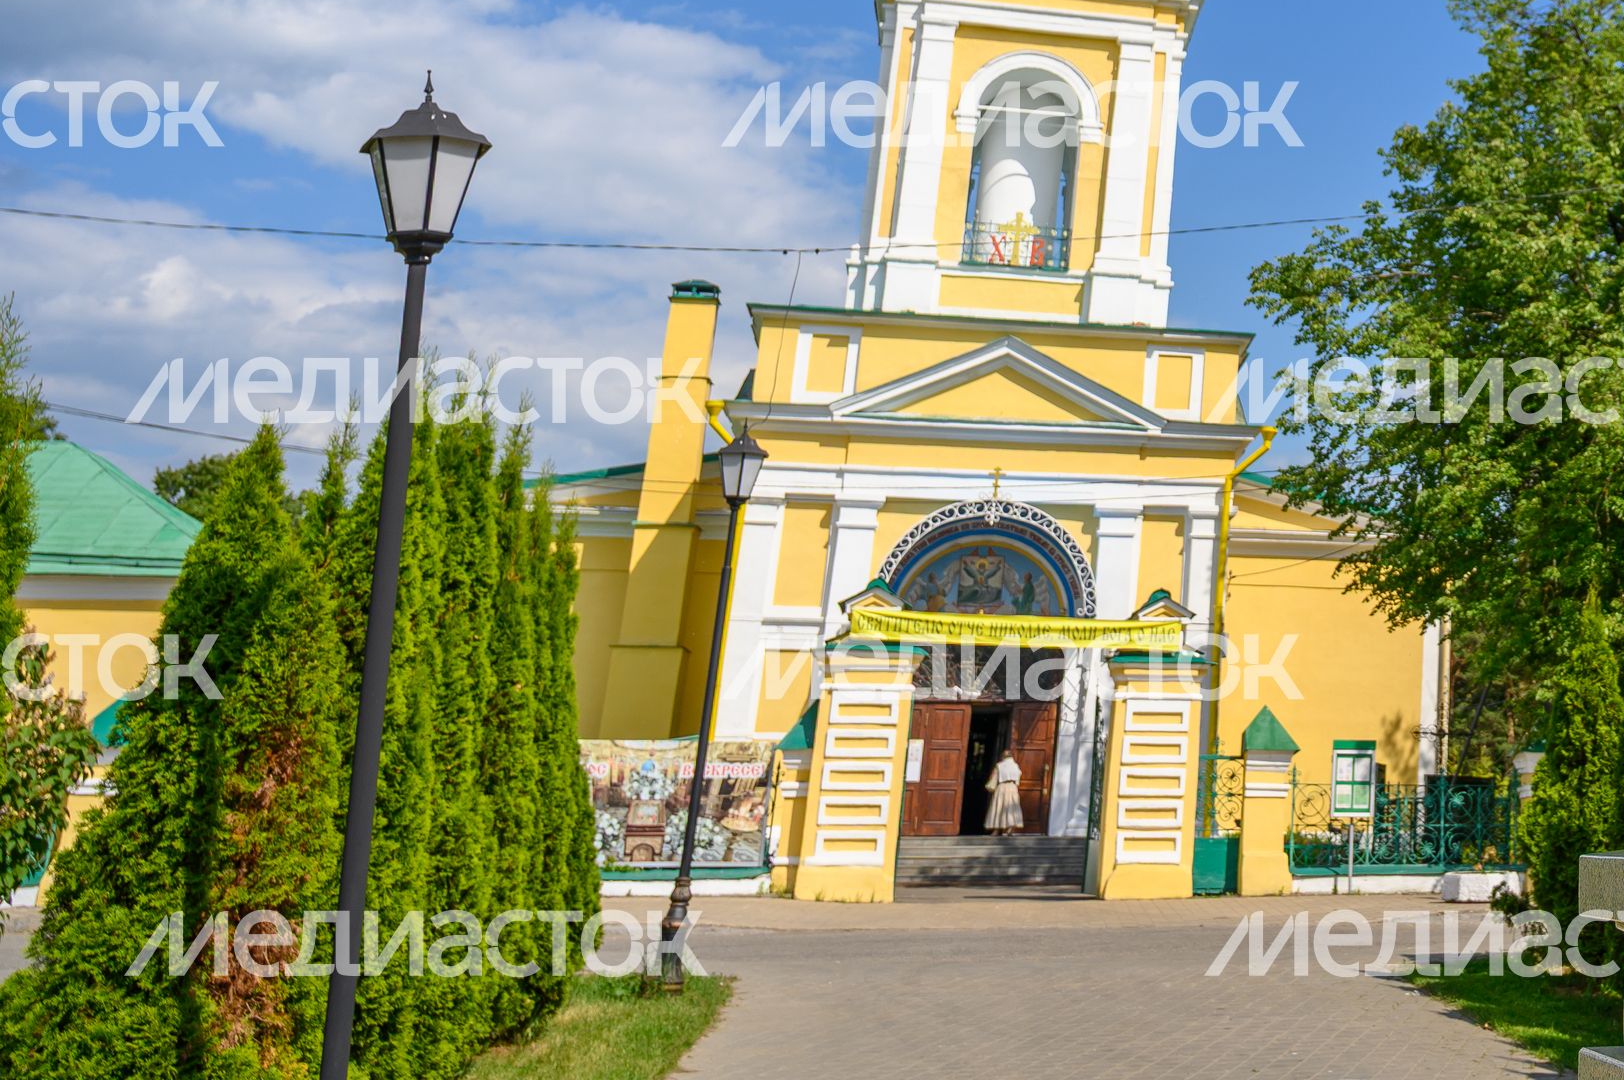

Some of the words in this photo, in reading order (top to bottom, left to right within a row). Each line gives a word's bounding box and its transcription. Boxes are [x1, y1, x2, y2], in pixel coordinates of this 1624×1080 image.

[1030, 237, 1045, 265] В
[948, 620, 985, 636] ОТЧЕ
[1137, 627, 1145, 642] О
[682, 762, 765, 777] ВСКРЕСЕ!
